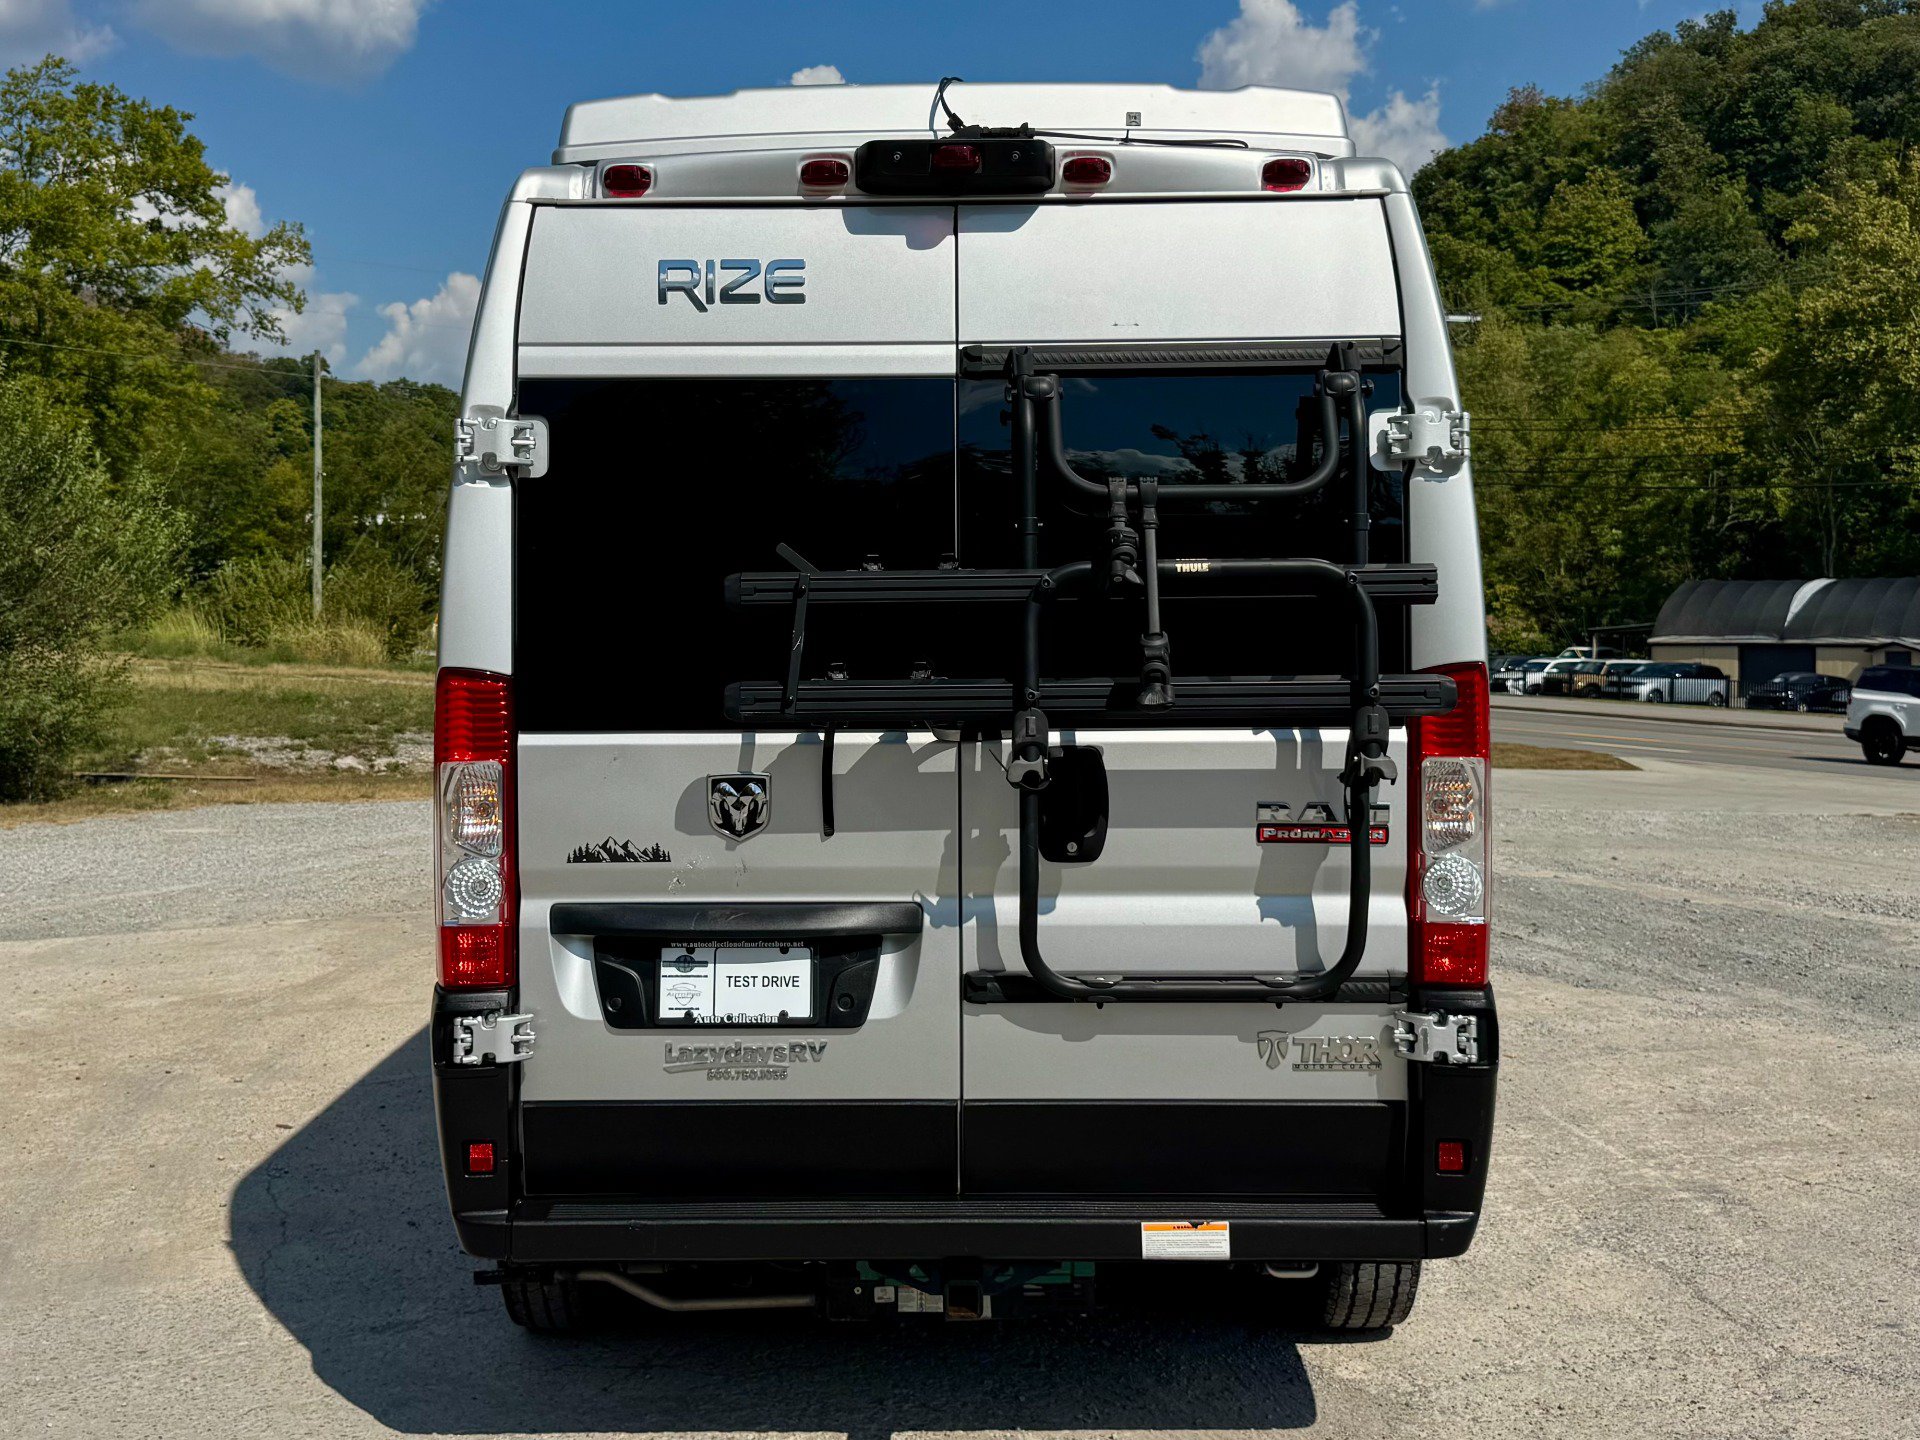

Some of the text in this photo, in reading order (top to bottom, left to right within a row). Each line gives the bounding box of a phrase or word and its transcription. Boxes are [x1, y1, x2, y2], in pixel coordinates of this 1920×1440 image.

[658, 259, 807, 313] RIZE
[1175, 562, 1210, 573] THULE
[726, 975, 800, 988] TEST DRIVE
[694, 1012, 779, 1024] Auto Collection
[1292, 1036, 1381, 1064] THOR
